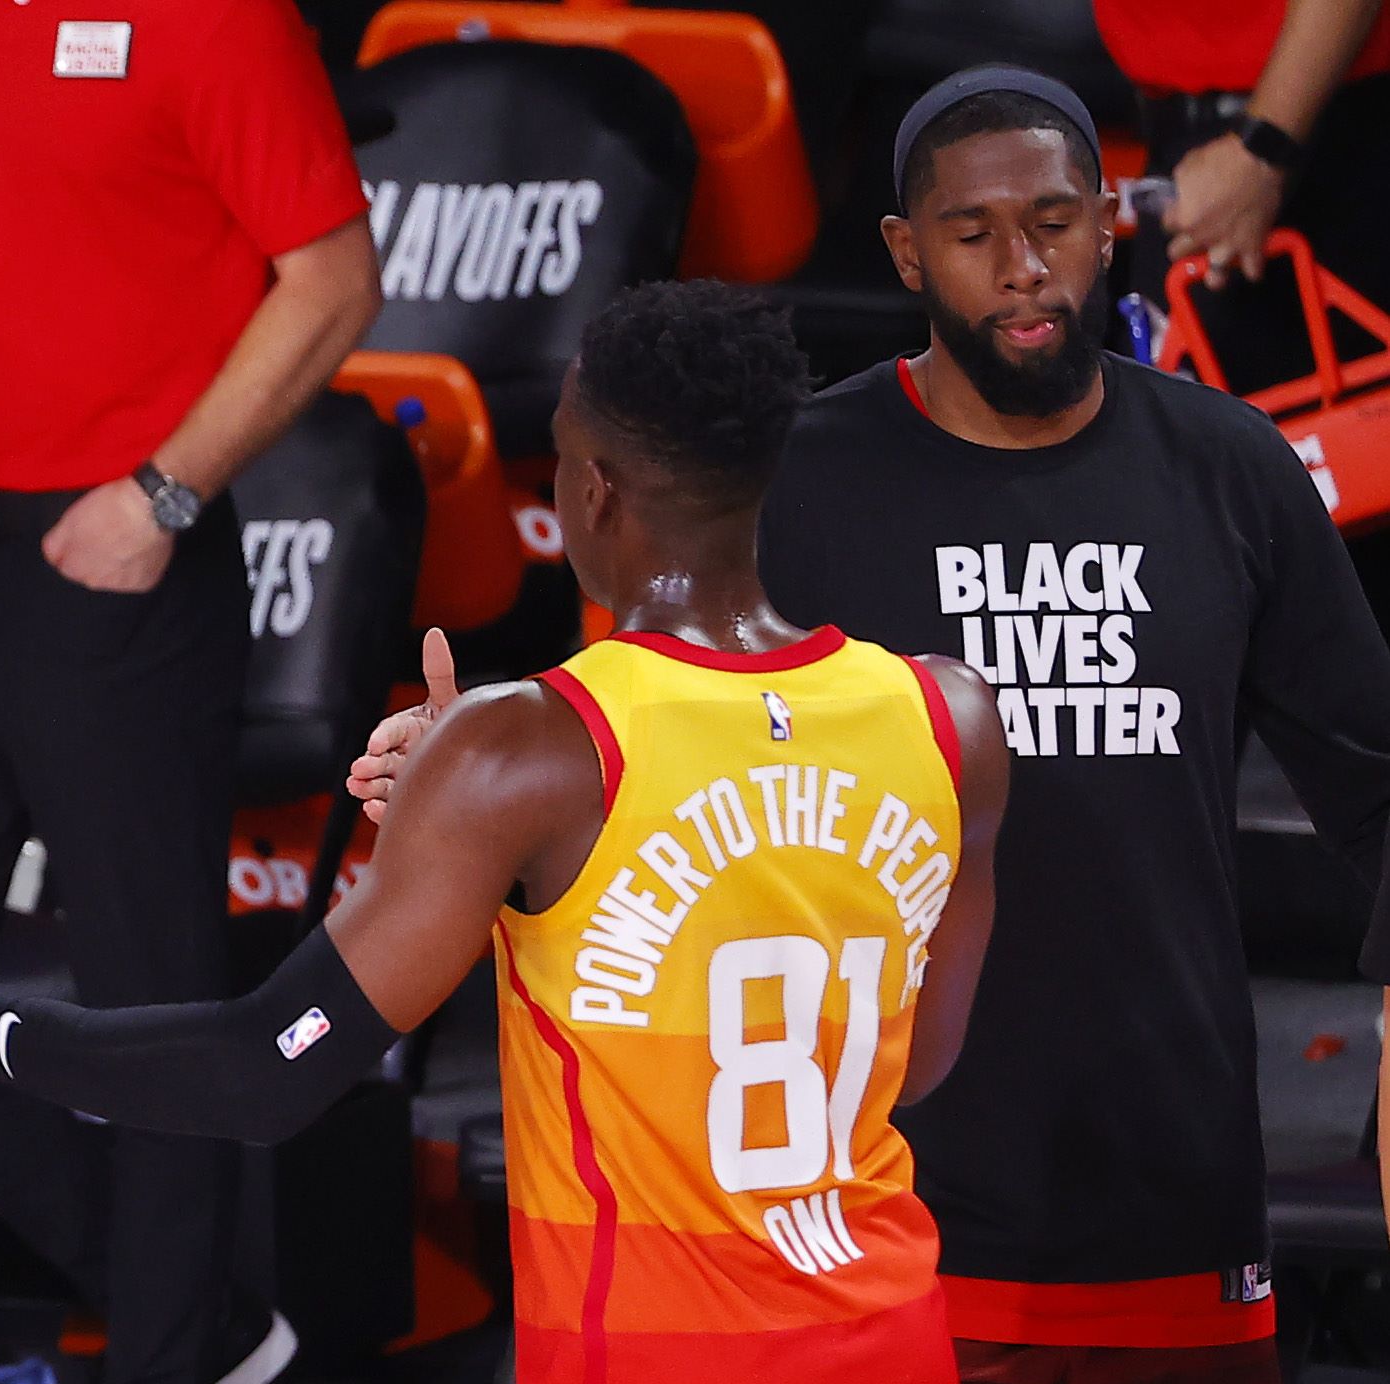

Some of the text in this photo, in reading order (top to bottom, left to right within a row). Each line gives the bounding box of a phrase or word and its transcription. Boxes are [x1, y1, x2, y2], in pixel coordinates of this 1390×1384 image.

[935, 542, 1152, 614] BLACK
[962, 614, 1137, 684] LIVES
[996, 687, 1181, 756] ATTER
[569, 831, 714, 1028] POWER
[674, 777, 758, 871] TO
[747, 764, 858, 855] THE
[706, 935, 887, 1194] 81
[761, 1188, 865, 1276] ONI
